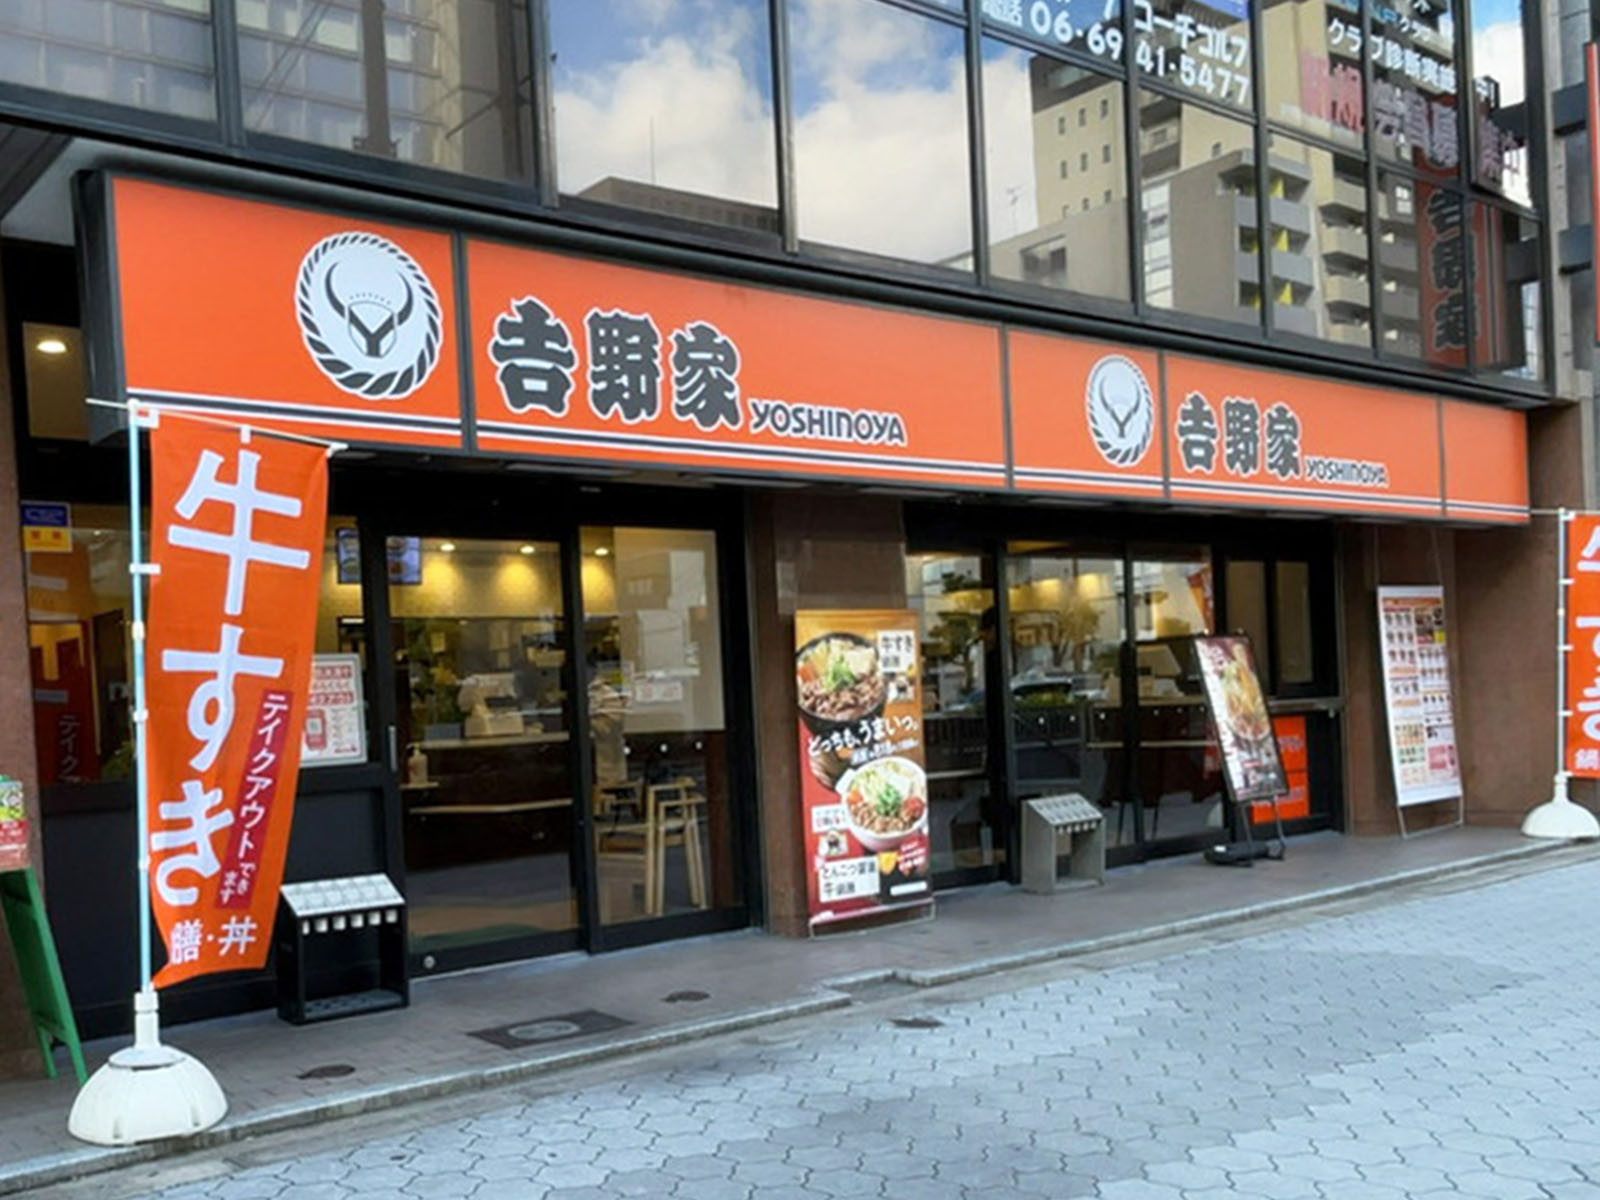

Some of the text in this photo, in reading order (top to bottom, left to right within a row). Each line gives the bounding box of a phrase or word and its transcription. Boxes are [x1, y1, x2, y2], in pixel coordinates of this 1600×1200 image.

[490, 296, 742, 430] 吉野家
[750, 399, 907, 447] YOSHINOYA
[1176, 391, 1301, 480] 吉野家
[149, 448, 311, 908] 牛すき
